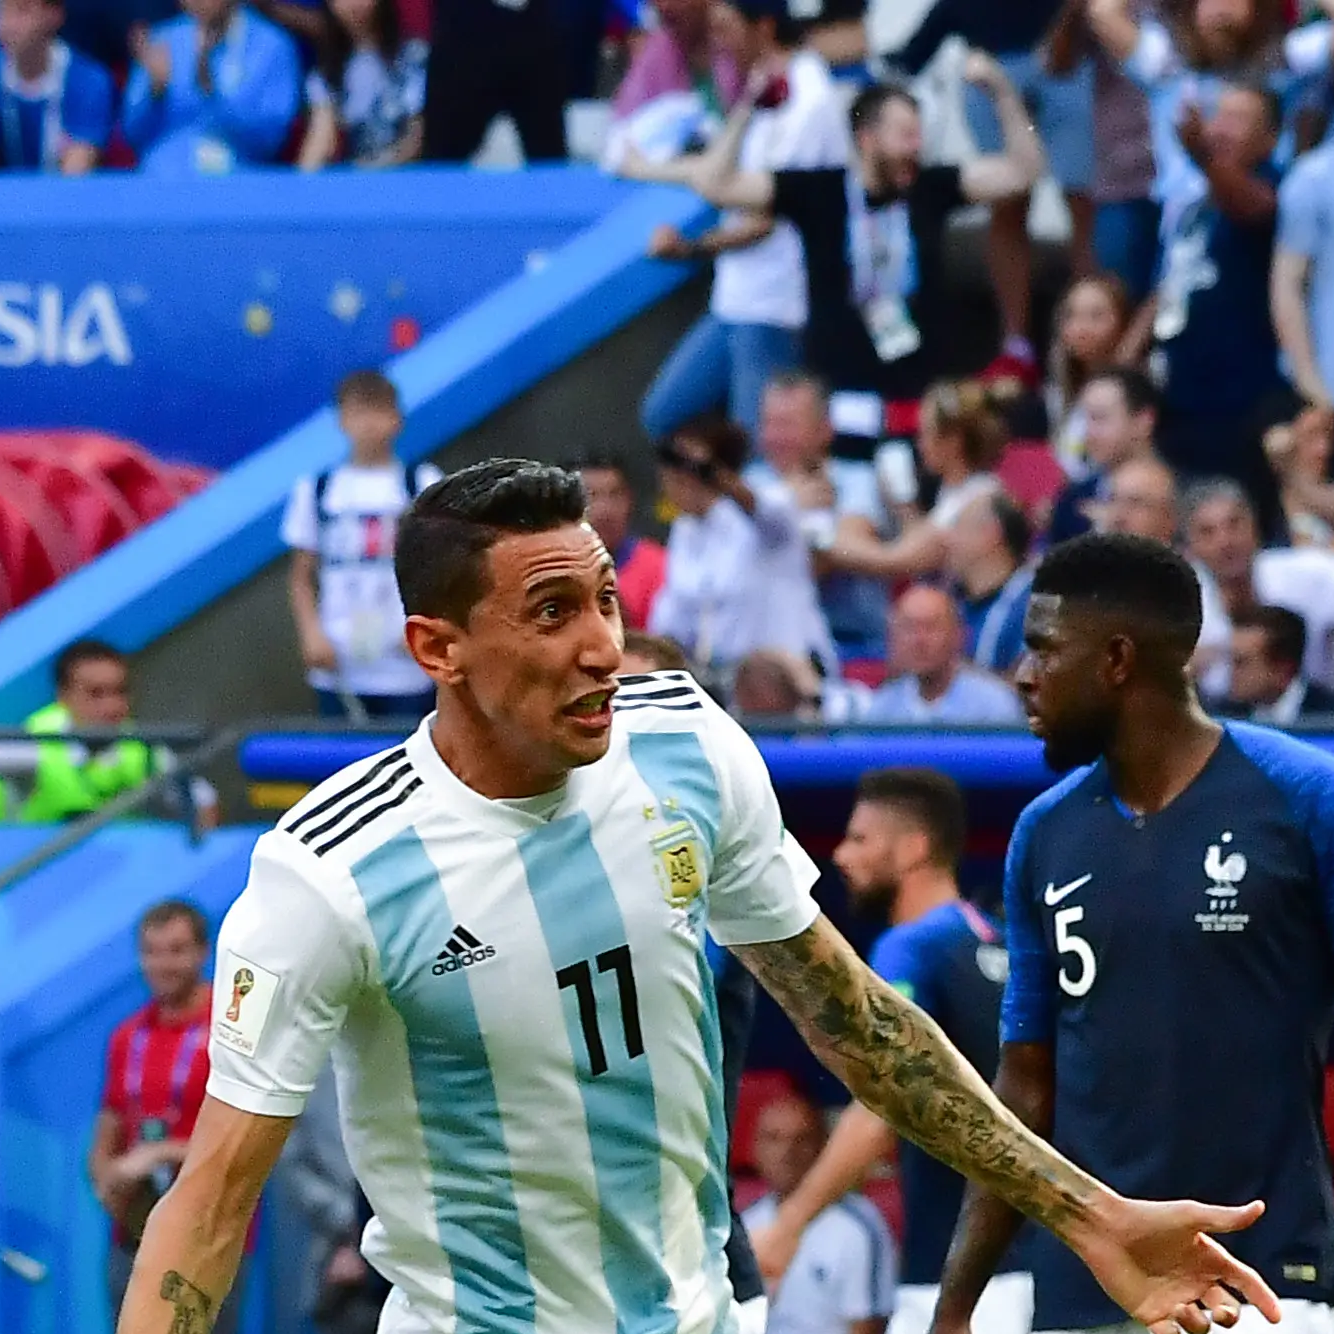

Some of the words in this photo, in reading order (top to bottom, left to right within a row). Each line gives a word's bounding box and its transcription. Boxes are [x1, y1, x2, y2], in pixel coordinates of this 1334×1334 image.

[431, 944, 497, 976] adidas
[1054, 904, 1097, 997] 5
[555, 943, 645, 1077] 11
